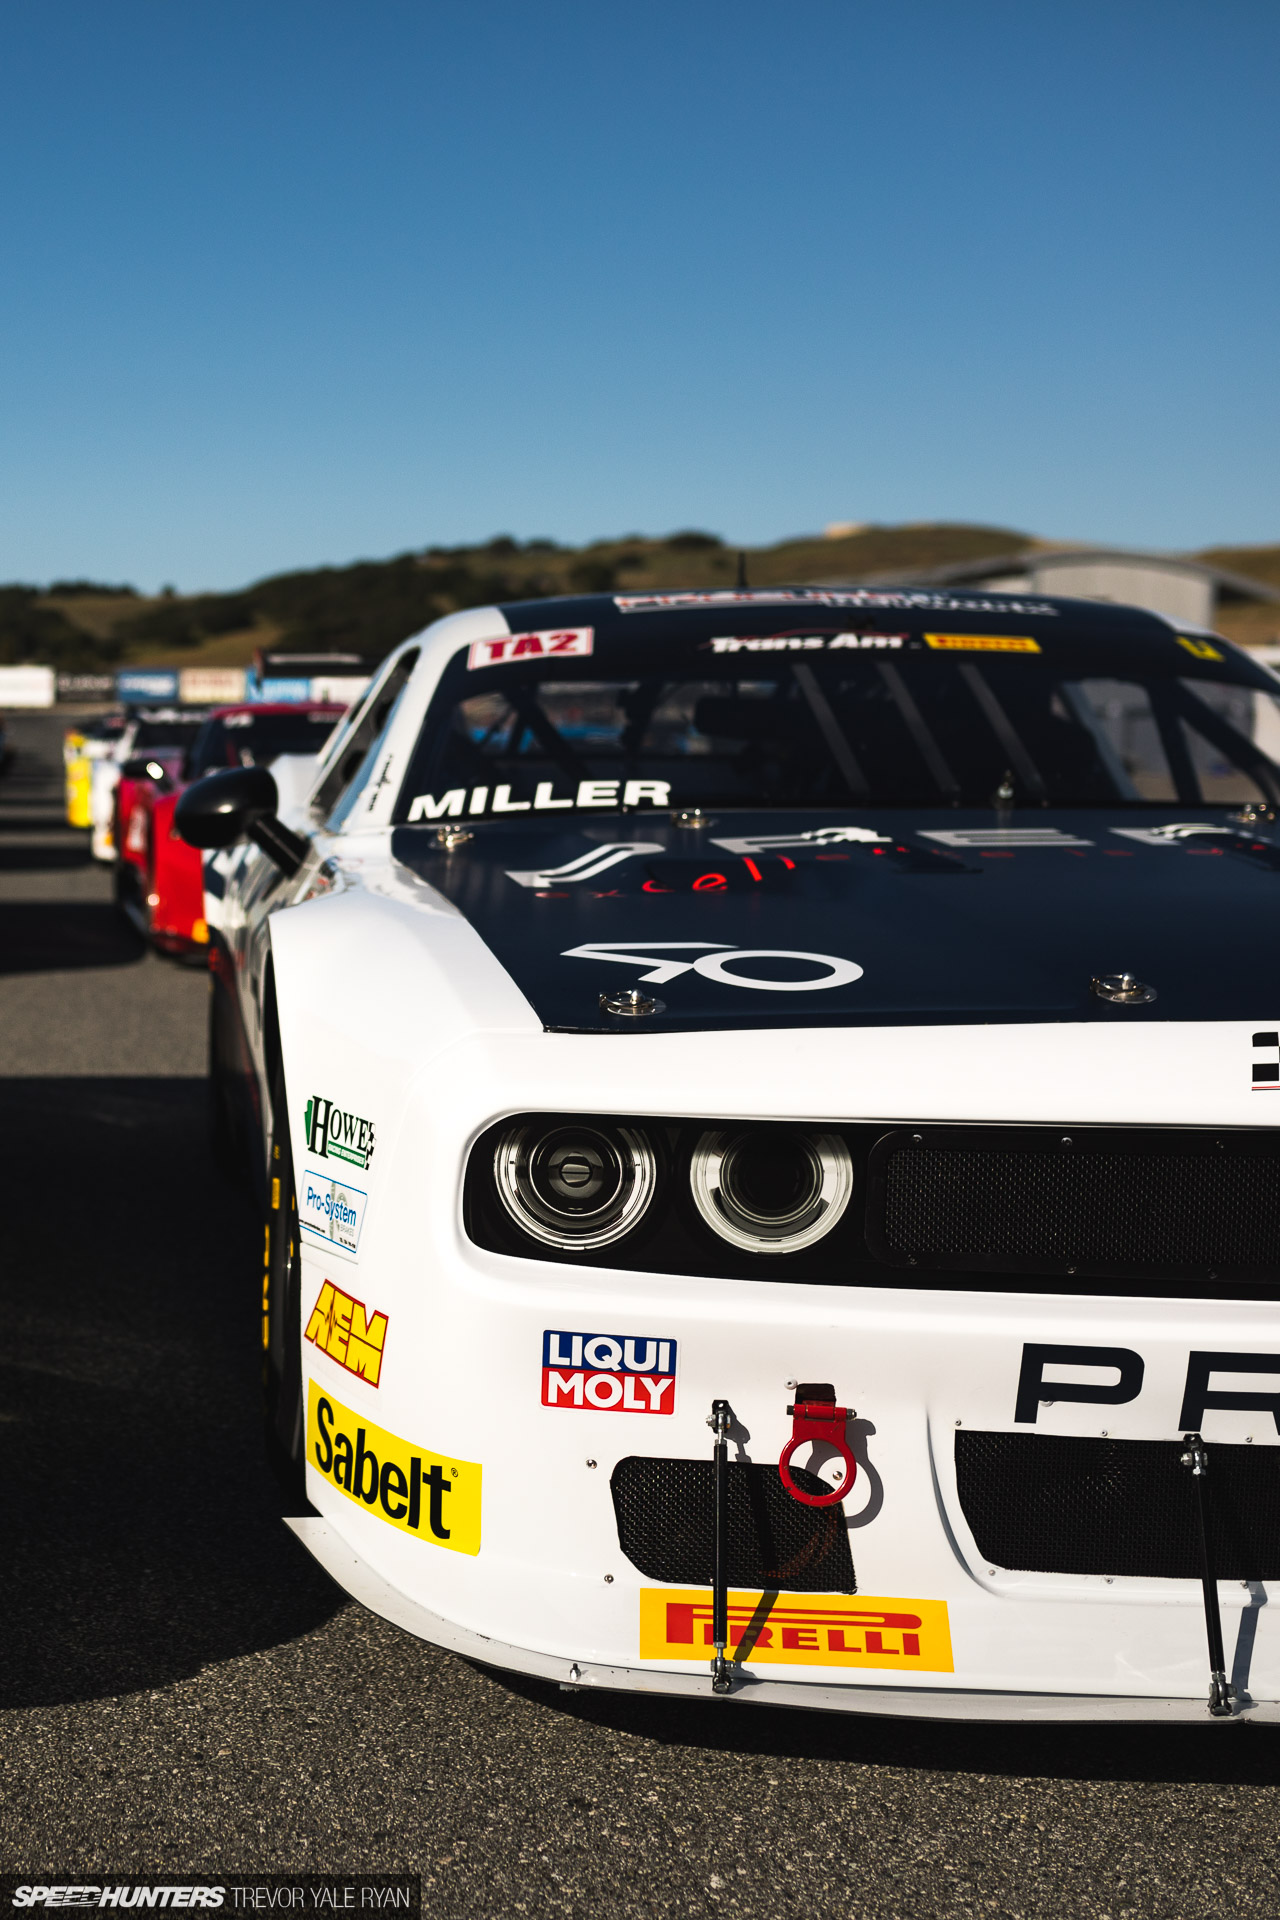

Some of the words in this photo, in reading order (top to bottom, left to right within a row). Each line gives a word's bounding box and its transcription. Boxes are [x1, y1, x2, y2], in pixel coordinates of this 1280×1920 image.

[485, 633, 579, 660] TA2
[711, 637, 824, 653] Trans
[827, 633, 903, 649] Am
[407, 780, 671, 822] MILLER
[560, 942, 864, 991] 40
[306, 1186, 357, 1227] Pro-System
[304, 1279, 389, 1389] AEM
[549, 1333, 671, 1372] LIQUI
[547, 1370, 674, 1411] MOLY
[315, 1397, 452, 1540] Sabelt
